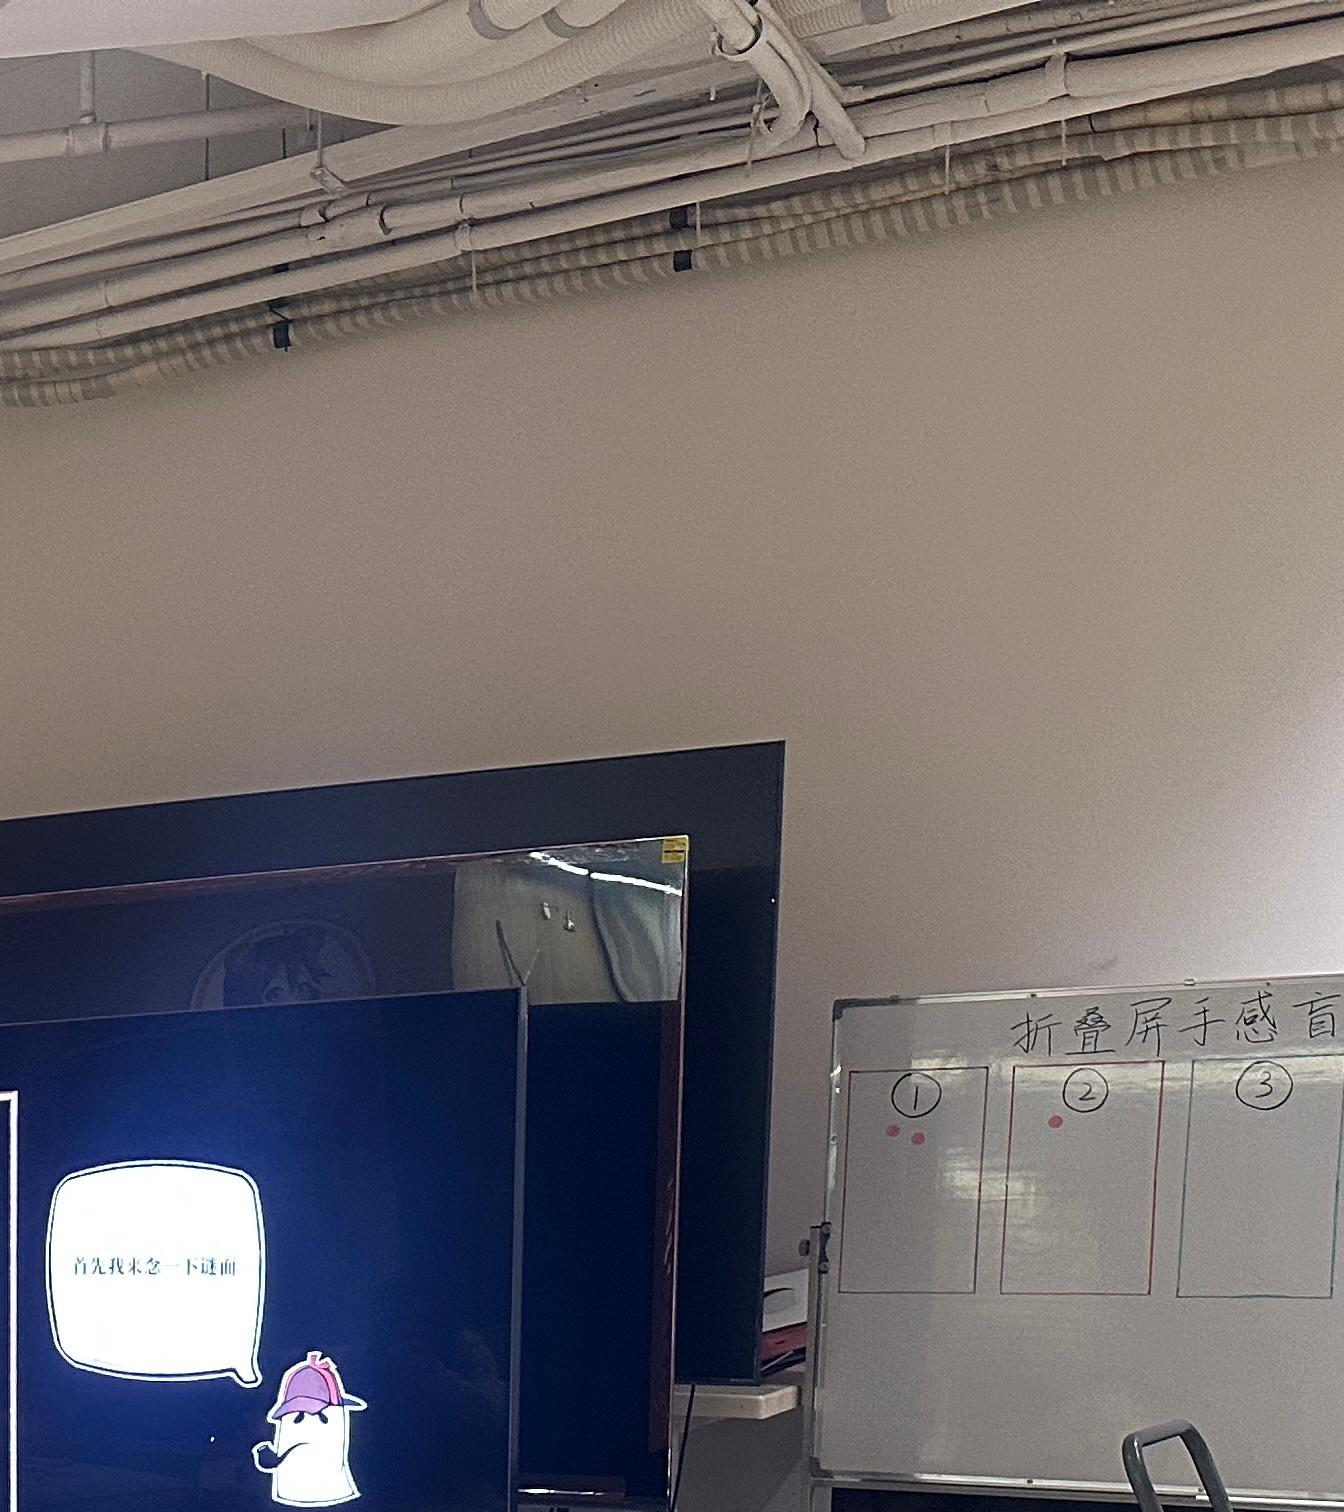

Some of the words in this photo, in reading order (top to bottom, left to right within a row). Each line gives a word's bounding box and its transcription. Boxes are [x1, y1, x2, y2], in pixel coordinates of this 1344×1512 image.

[1011, 991, 1344, 1057] 折叠屏手感盲
[74, 1256, 236, 1277] 首先我来念一下谜面
